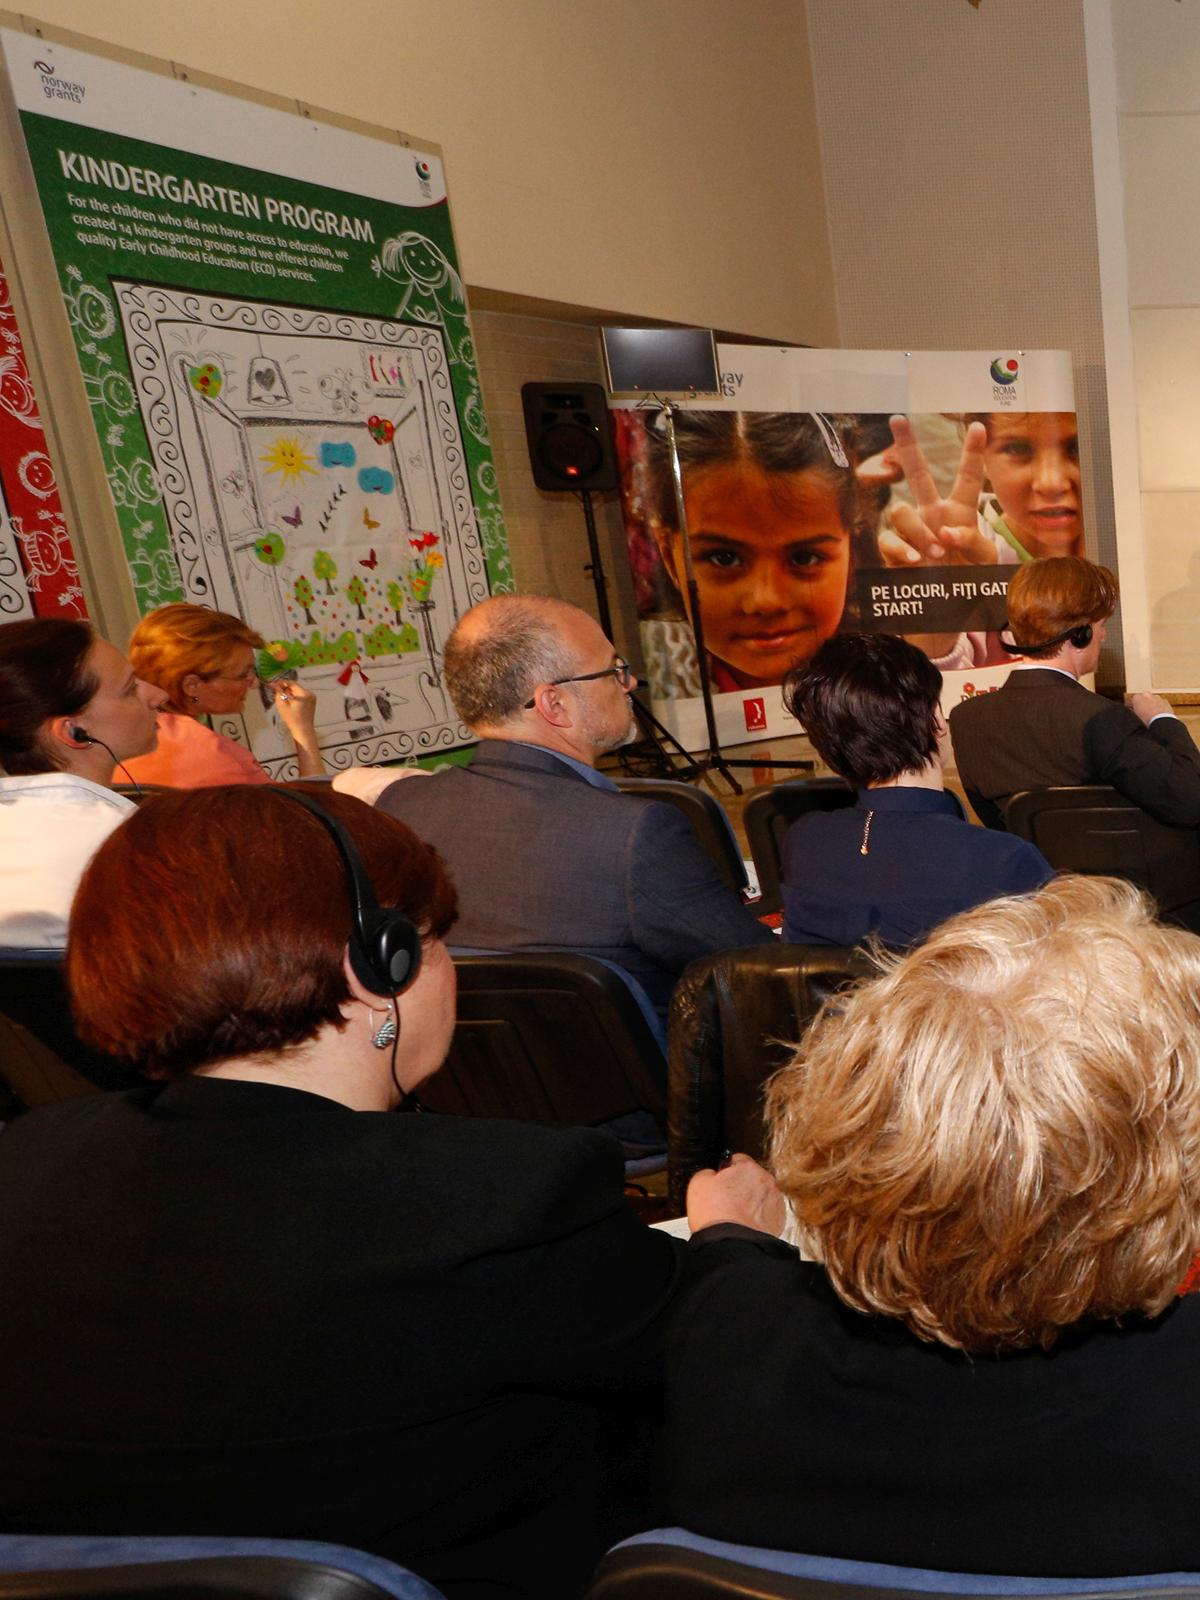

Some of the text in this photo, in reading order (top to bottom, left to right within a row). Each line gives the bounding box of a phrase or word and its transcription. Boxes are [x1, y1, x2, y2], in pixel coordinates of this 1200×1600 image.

[41, 74, 86, 98] norway
[43, 86, 82, 104] grants
[58, 150, 375, 244] KINDERGARTEN PROGRAM
[67, 193, 350, 261] For the children who did not have access to education, we
[72, 214, 344, 273] created 14 kindergarten groups and we offered children
[77, 231, 317, 282] quality Early Childhood Education (ECD) services.
[992, 386, 1017, 396] ROMA
[871, 586, 890, 600] PE
[893, 584, 950, 600] LOCURI,
[873, 600, 923, 617] START!
